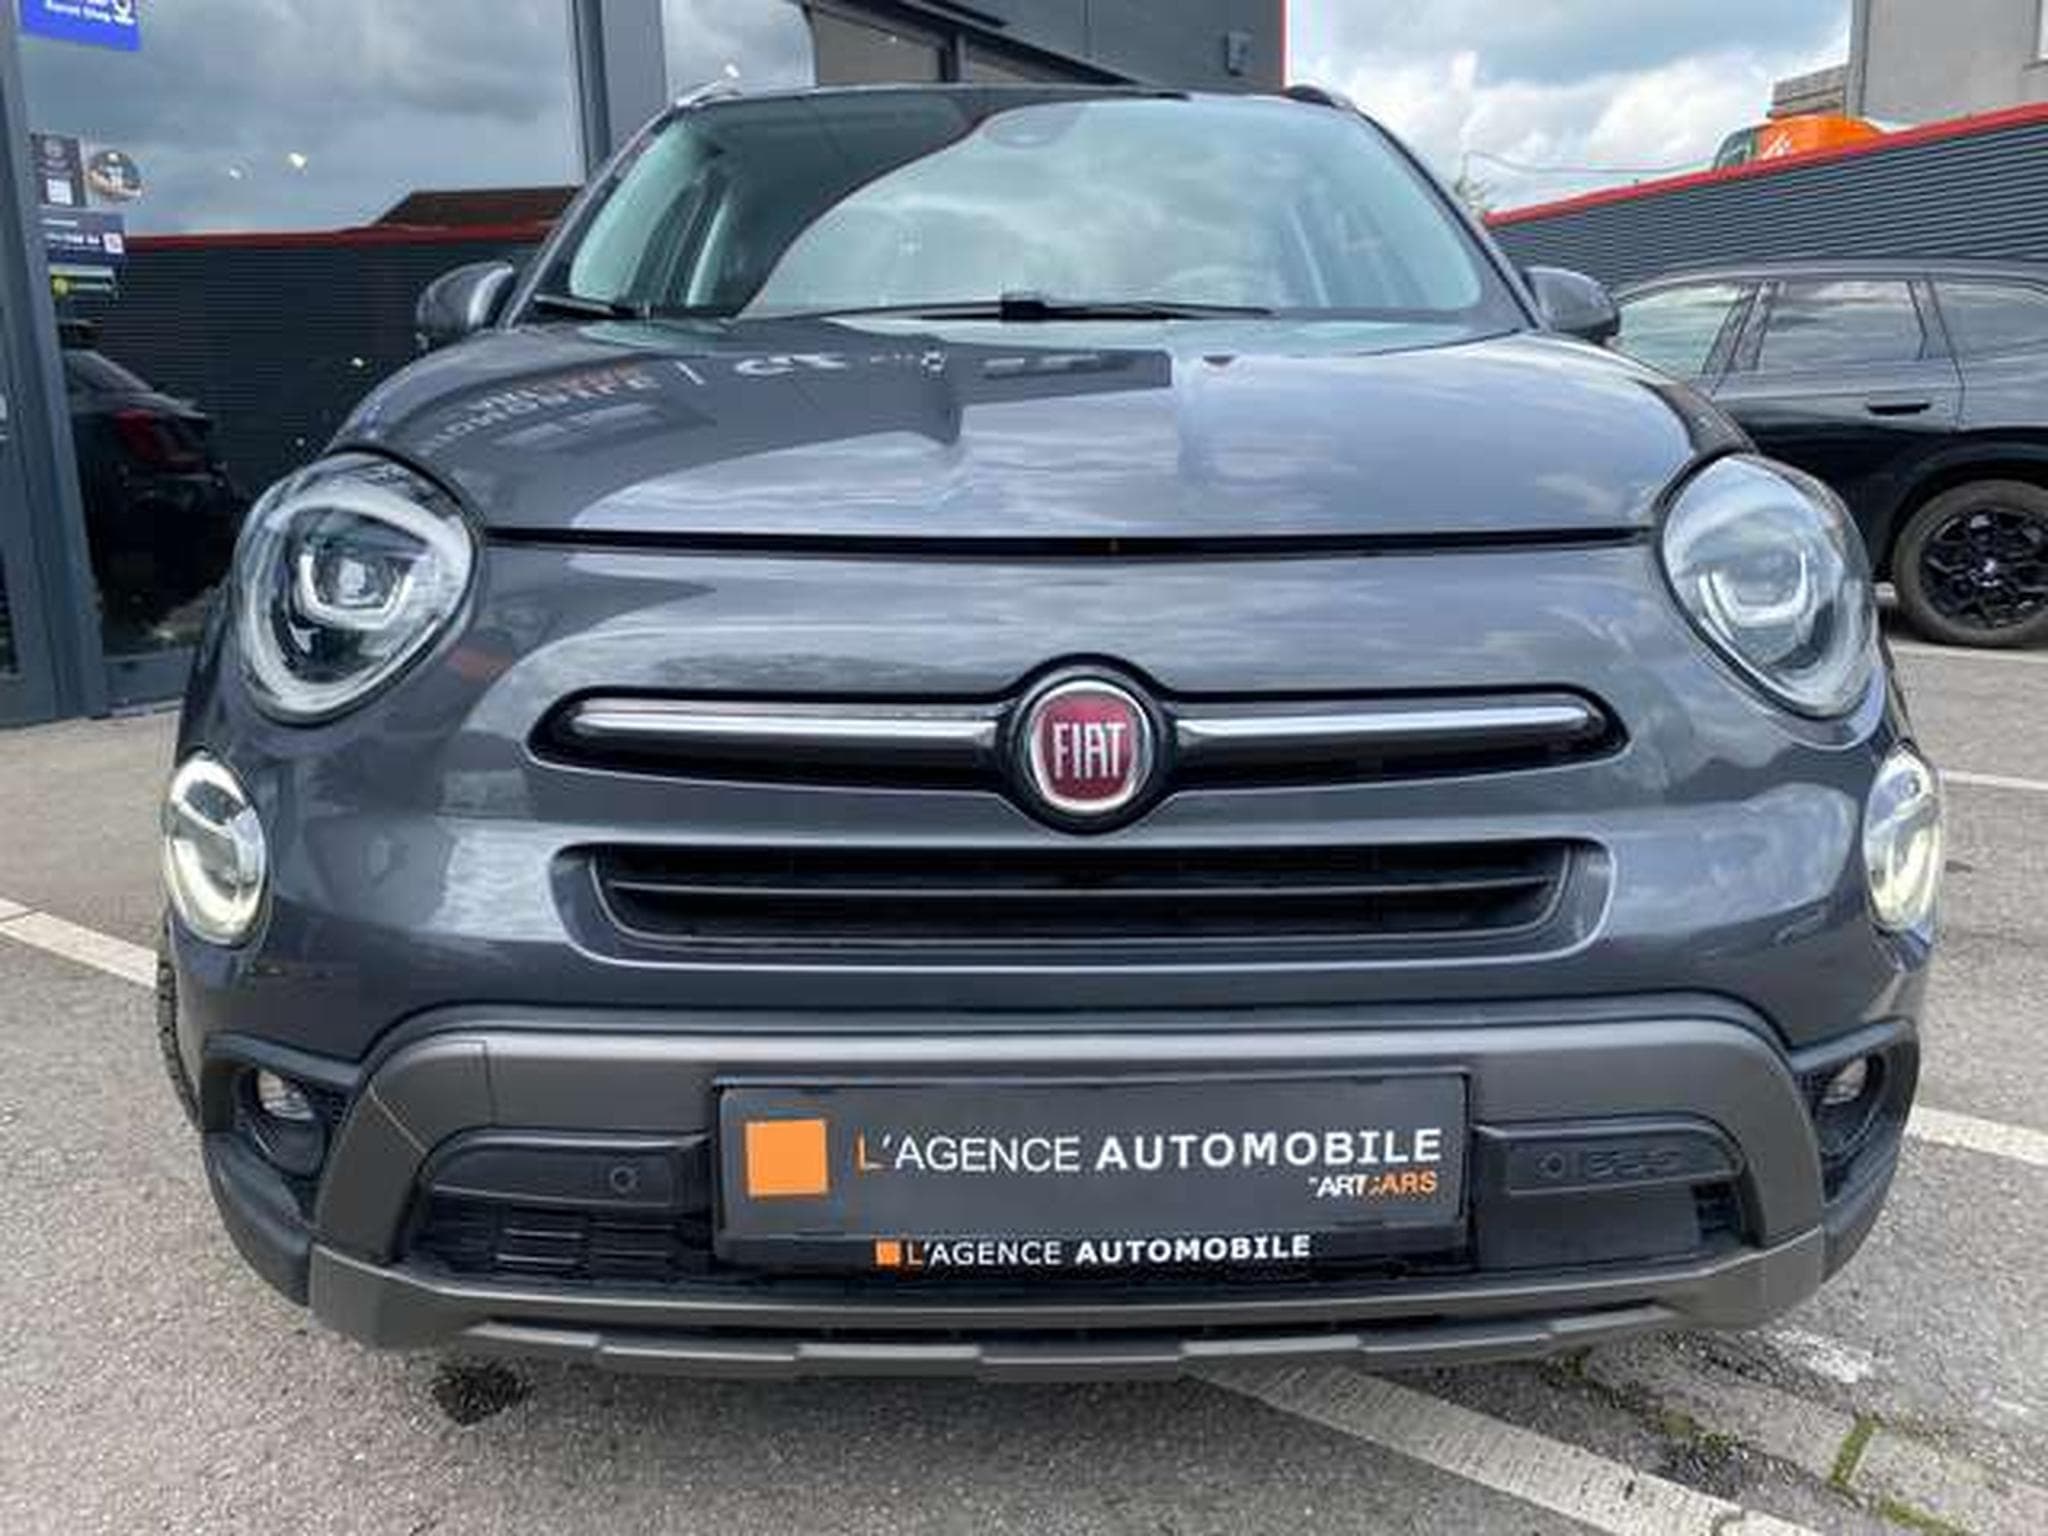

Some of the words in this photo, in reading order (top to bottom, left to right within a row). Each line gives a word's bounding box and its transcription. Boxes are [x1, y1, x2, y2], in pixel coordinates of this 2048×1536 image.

[1053, 722, 1127, 779] FIAT
[855, 1133, 1080, 1173] L'AGENCE
[1095, 1127, 1442, 1171] AUTOMOBILE
[906, 1240, 1063, 1266] L'AGENCE
[1075, 1234, 1311, 1265] AUTOMOBILE
